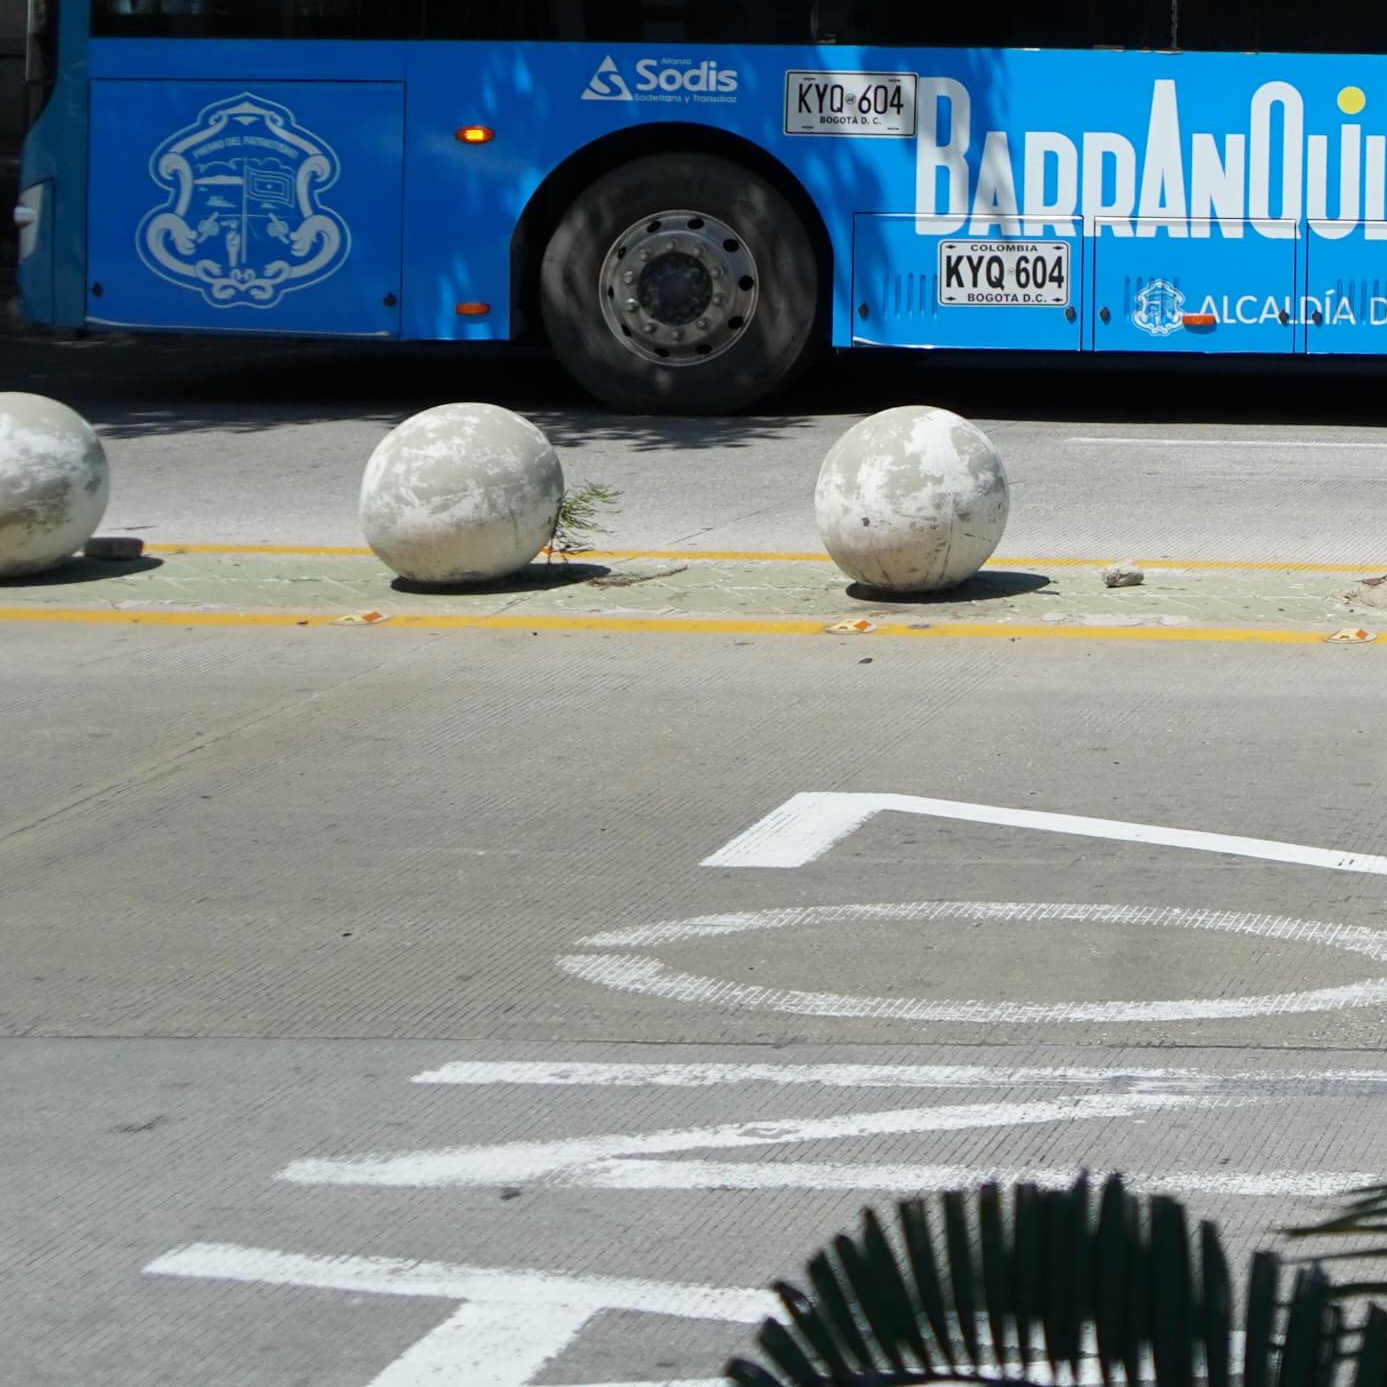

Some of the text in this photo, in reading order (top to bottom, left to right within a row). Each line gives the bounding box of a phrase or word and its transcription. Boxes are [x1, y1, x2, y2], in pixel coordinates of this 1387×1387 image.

[635, 58, 738, 92] Sodis
[798, 83, 904, 115] KYQ 604
[970, 244, 1038, 253] COLOMBIA
[945, 255, 1064, 291] KYQ 604
[967, 293, 1019, 303] BOGOTA
[1199, 287, 1357, 326] ALCALDÍA
